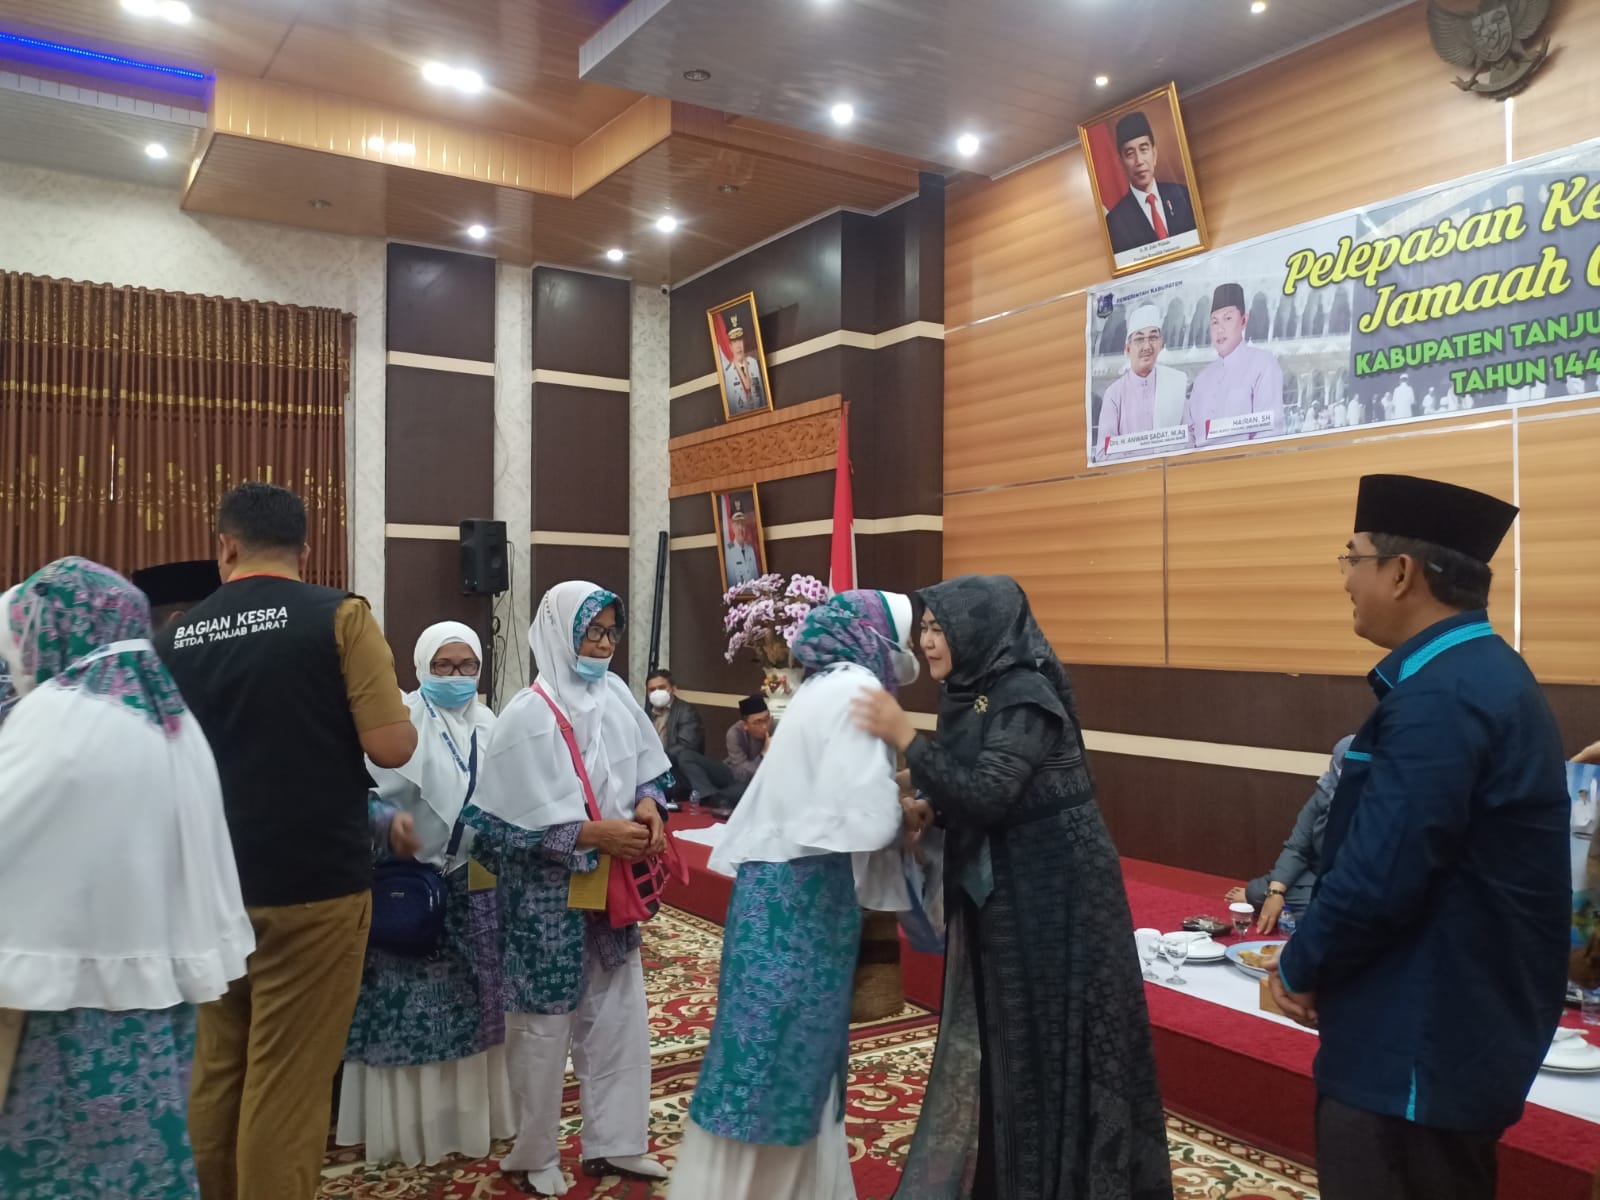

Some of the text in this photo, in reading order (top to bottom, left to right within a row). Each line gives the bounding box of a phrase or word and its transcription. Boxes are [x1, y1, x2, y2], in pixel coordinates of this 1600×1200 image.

[1283, 203, 1527, 295] Pelepasan
[1358, 247, 1572, 334] Jamaah
[1355, 309, 1600, 376] KABUPATEN TANJU
[1451, 349, 1600, 394] TAHUN 144
[173, 619, 288, 649] SETDA TANJAB BARAT
[174, 606, 288, 639] BAGIAN KESRA
